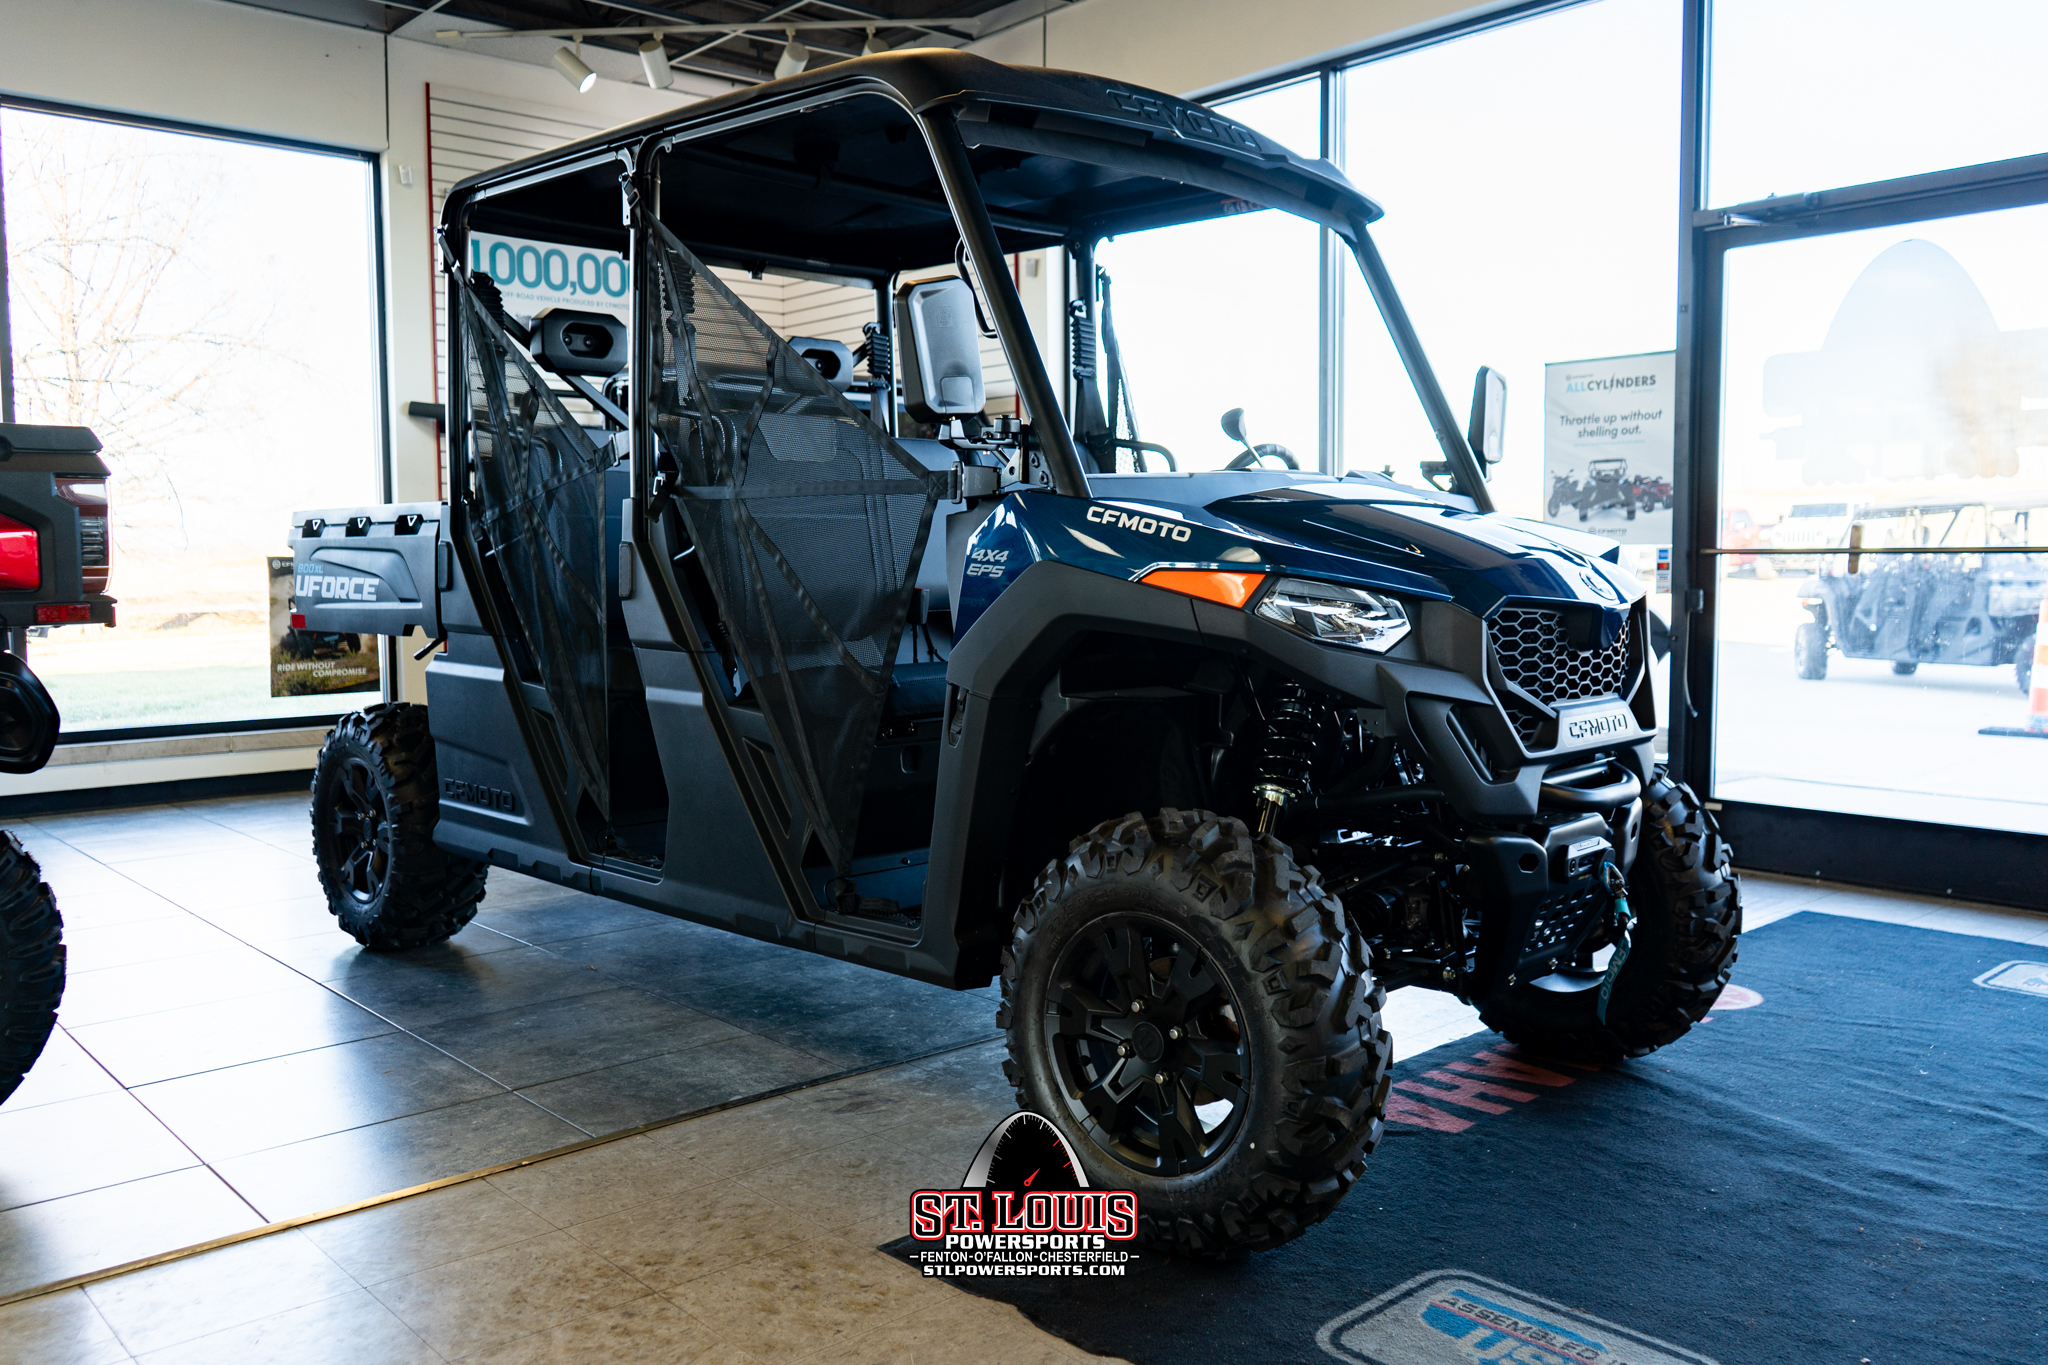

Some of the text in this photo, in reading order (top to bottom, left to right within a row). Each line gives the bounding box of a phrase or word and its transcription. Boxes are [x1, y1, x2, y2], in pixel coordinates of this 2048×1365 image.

[537, 295, 561, 303] VEHICLE
[562, 298, 595, 307] PRODUCED
[1560, 409, 1662, 426] Throttle up without
[1578, 424, 1641, 439] shelling out.
[1087, 506, 1192, 543] CFMOTO
[966, 564, 1006, 578] EPS
[295, 575, 380, 601] UFORCE
[277, 661, 336, 672] RIDE WITHOUT
[312, 667, 367, 678] COMPROMISE
[1568, 713, 1628, 739] CFMOTO
[444, 777, 515, 811] CFMOTO
[1439, 1297, 1600, 1361] ASSEMBLED
